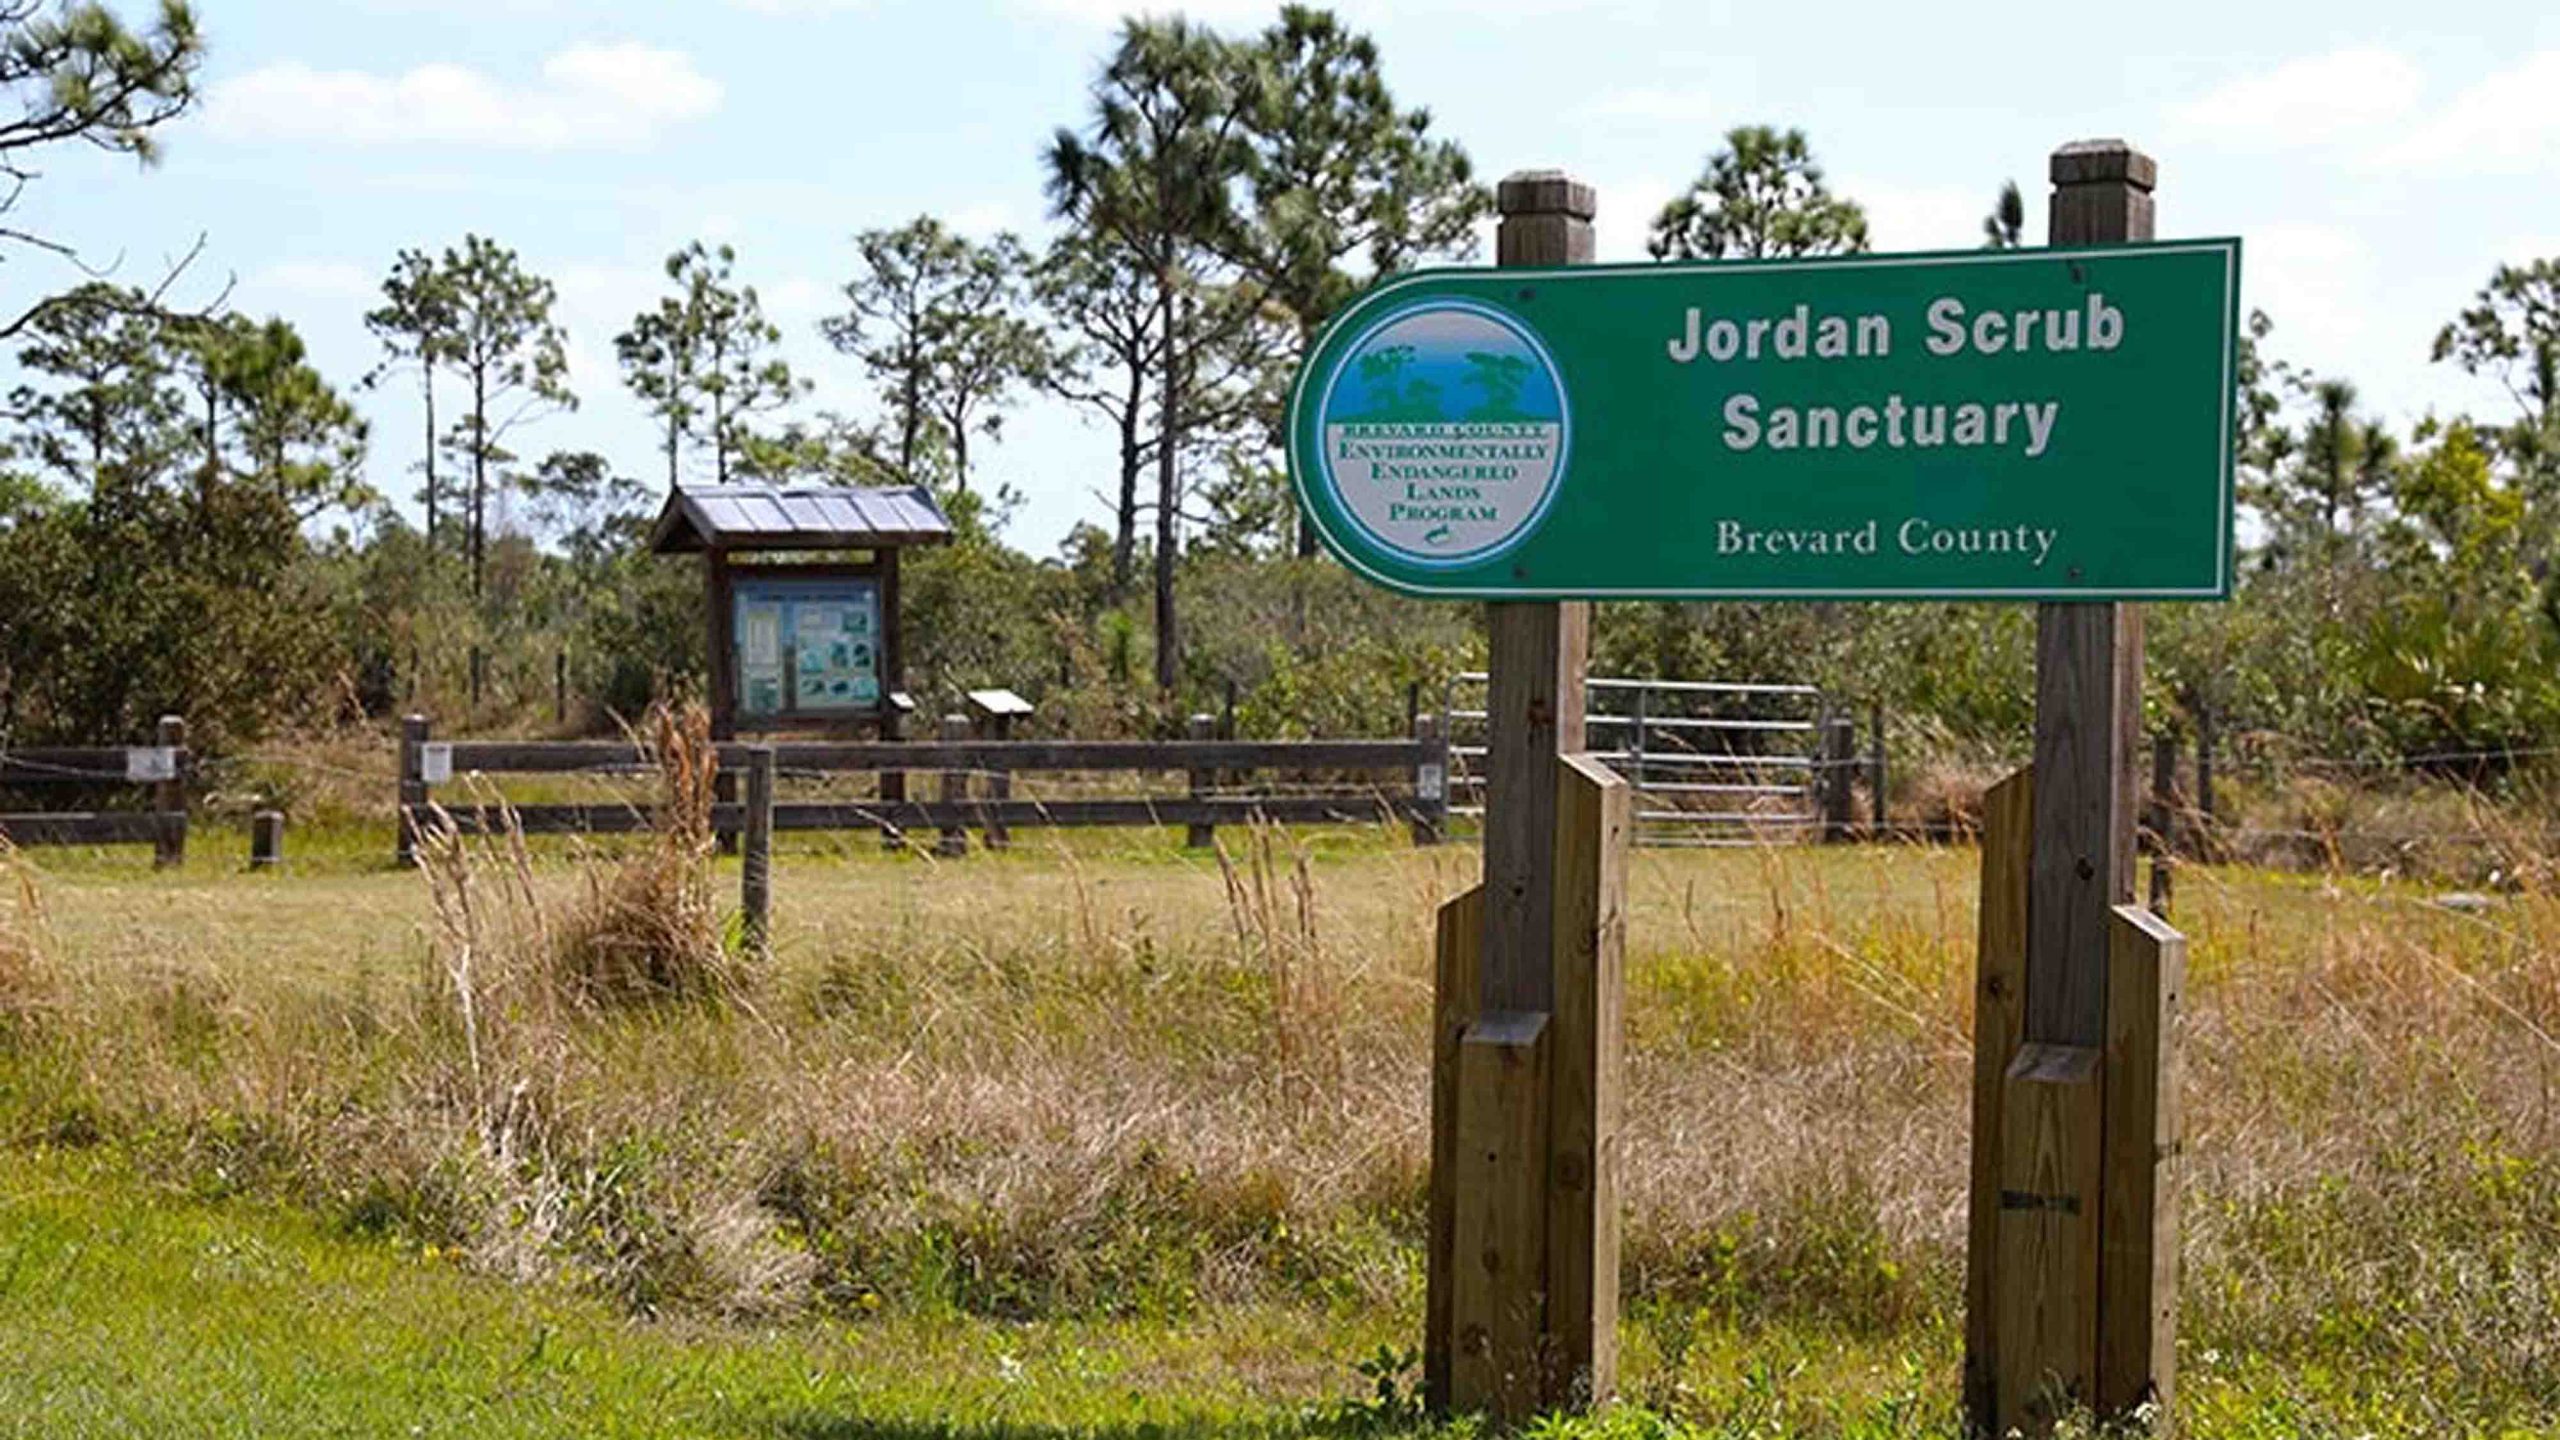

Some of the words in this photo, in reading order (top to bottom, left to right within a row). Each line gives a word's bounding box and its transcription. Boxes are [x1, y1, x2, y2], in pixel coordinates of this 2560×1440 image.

[1668, 304, 1890, 363] Jordan
[1926, 294, 2124, 355] Scrub
[1723, 394, 2058, 457] Sanctuary
[1339, 442, 1548, 459] ENVIRONMENTALLY
[1371, 463, 1518, 480] ENDANGERED
[1407, 483, 1481, 499] LANDS
[1389, 504, 1498, 521] PROGRAM
[1716, 520, 1877, 555] Brevard
[1899, 517, 2057, 565] County
